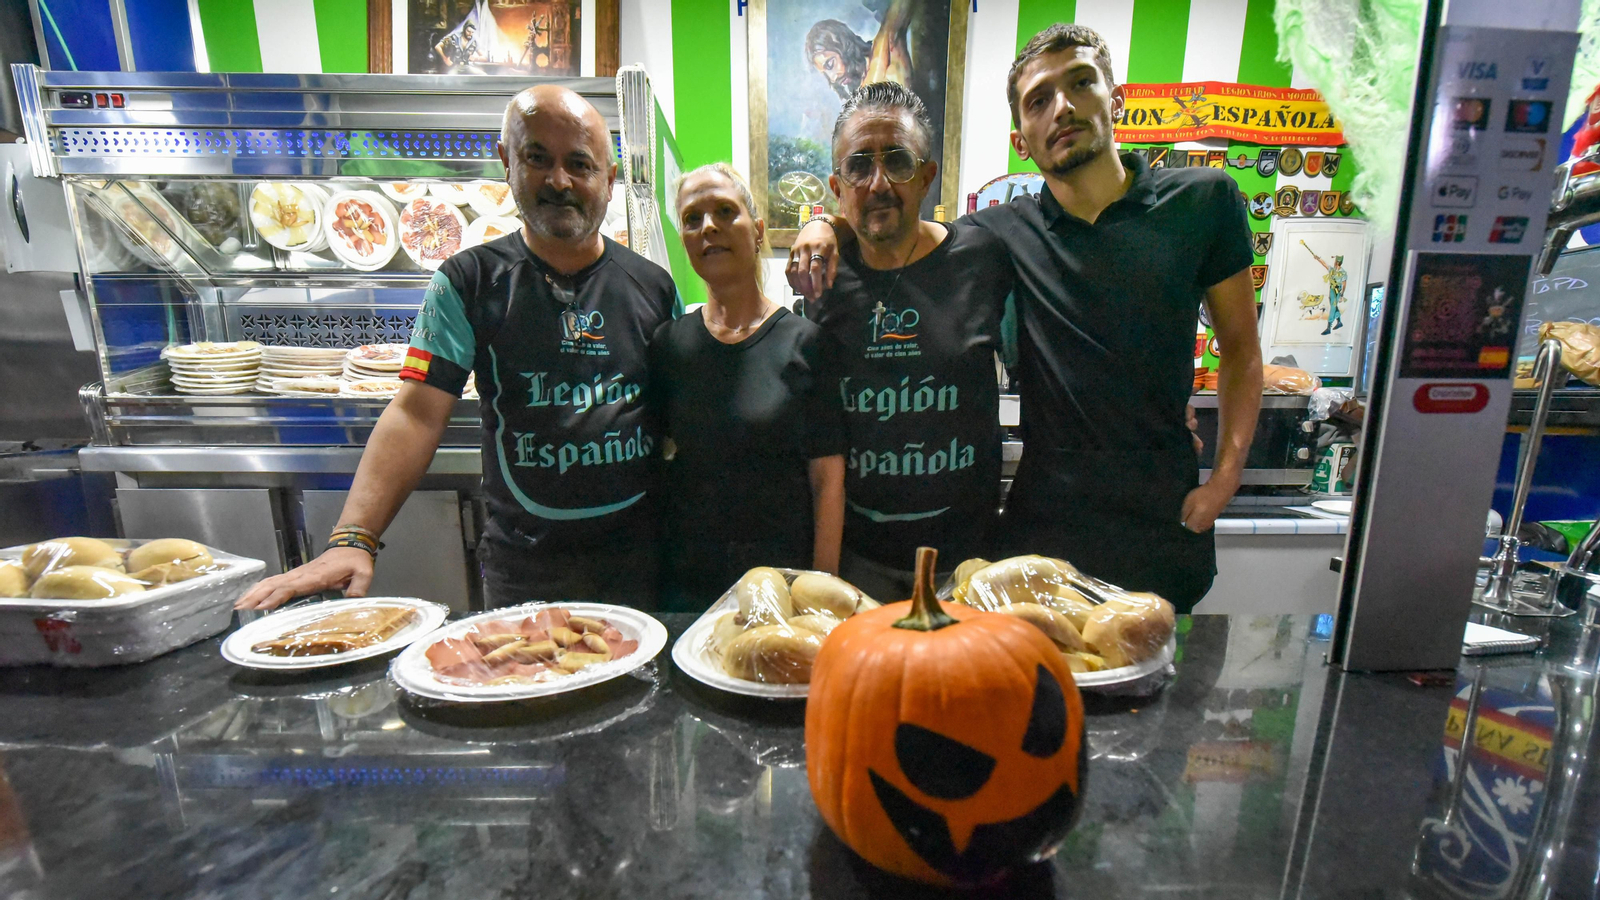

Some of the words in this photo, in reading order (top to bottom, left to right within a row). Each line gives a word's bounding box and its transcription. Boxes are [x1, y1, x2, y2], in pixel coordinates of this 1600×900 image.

[1458, 62, 1498, 80] VISA
[1220, 86, 1277, 99] LEGIONARIOS
[1212, 104, 1336, 129] ESPAÑOLA
[1449, 184, 1473, 200] Pay
[519, 372, 642, 414] Legión
[512, 425, 654, 475] Española
[848, 437, 976, 479] spañola
